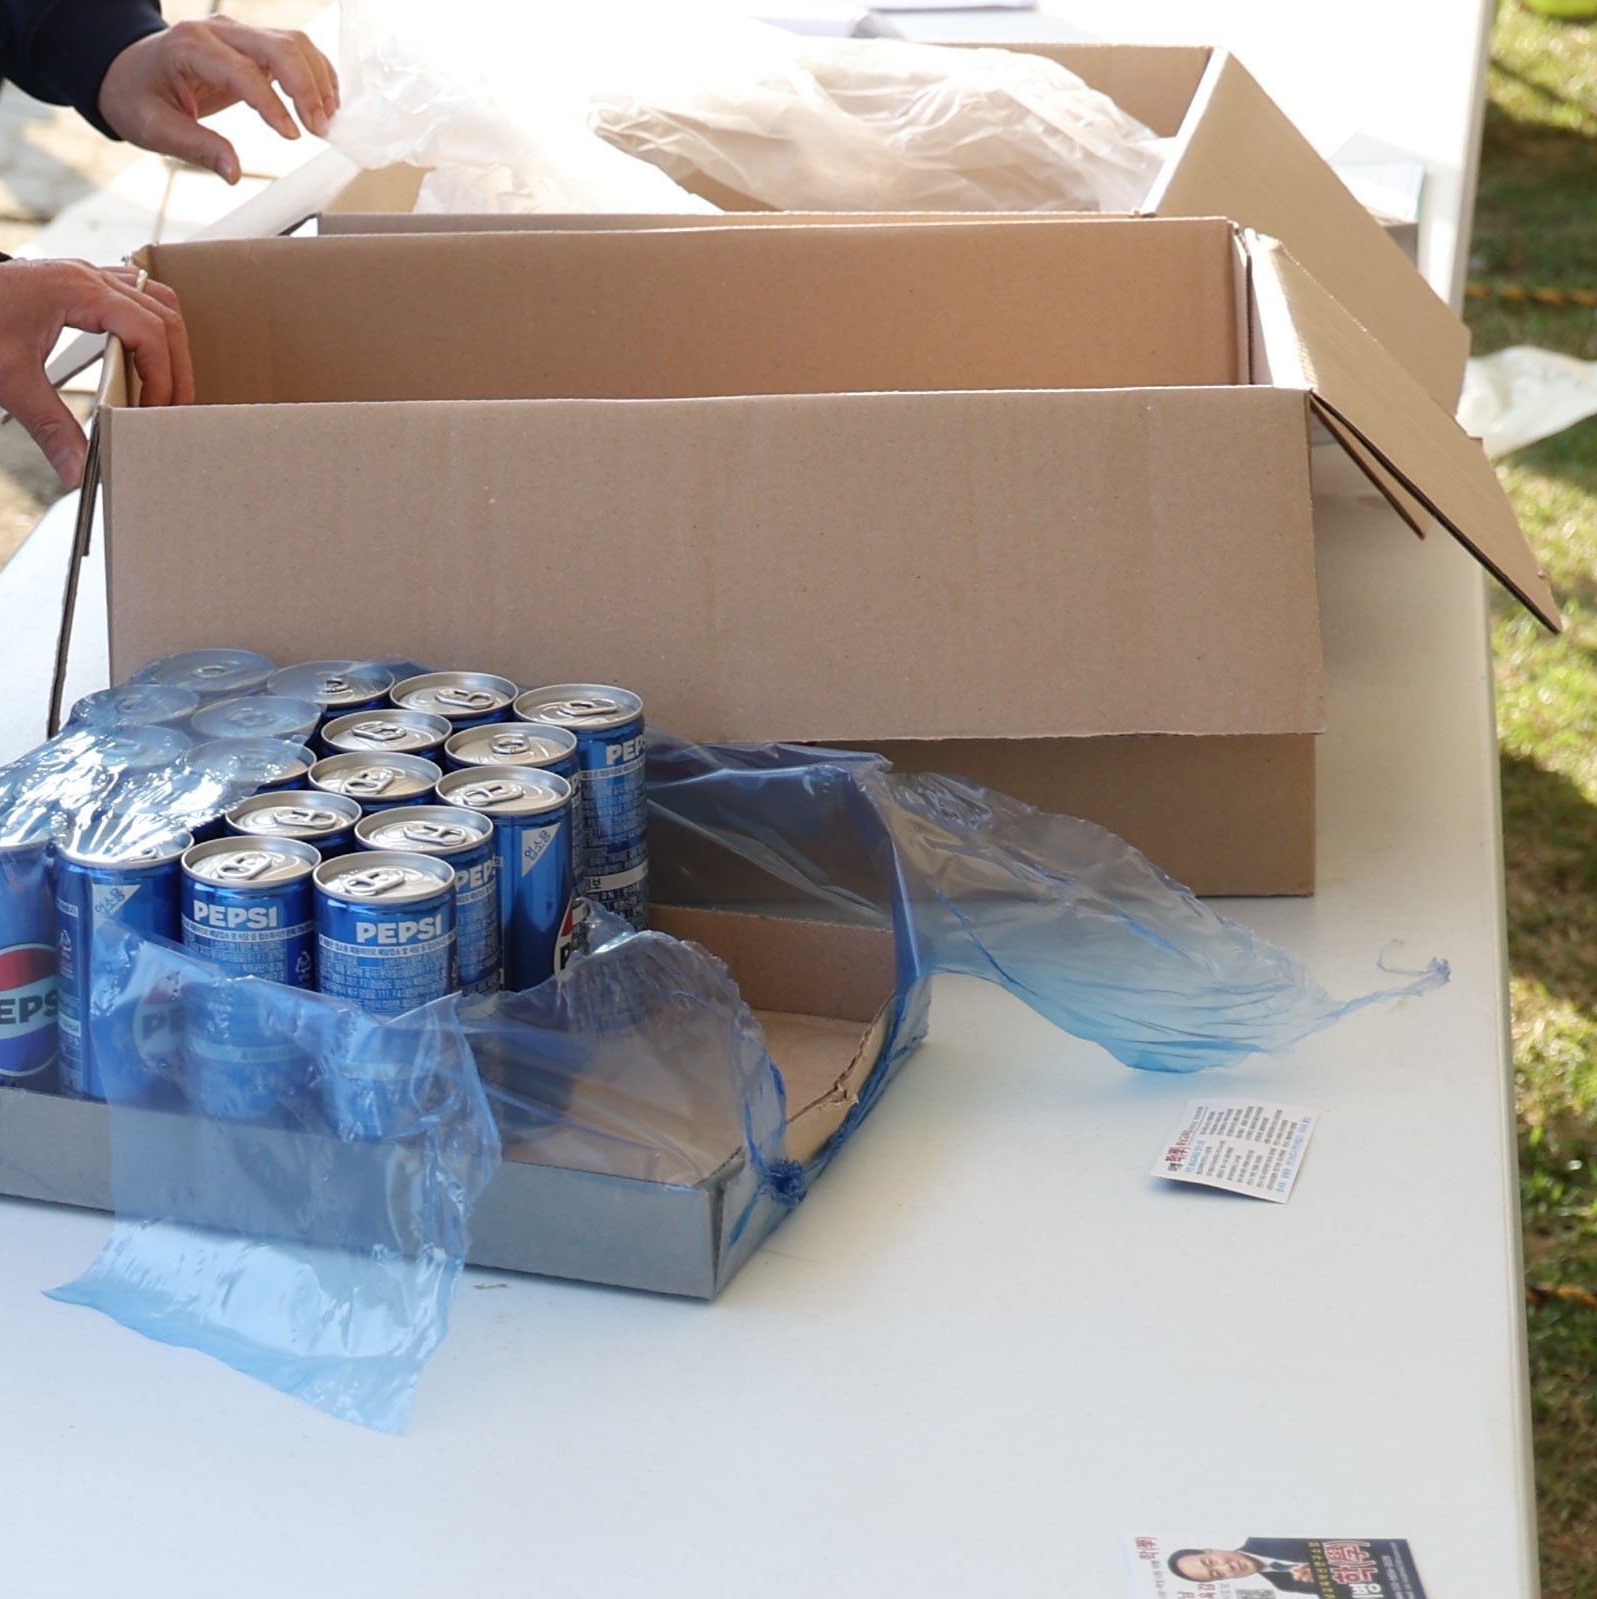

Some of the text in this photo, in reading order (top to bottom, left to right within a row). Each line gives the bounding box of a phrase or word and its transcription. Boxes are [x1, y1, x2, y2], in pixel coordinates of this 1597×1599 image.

[93, 886, 127, 916] 업소용
[193, 900, 277, 929] PEPSI
[356, 914, 442, 945] PEPSI
